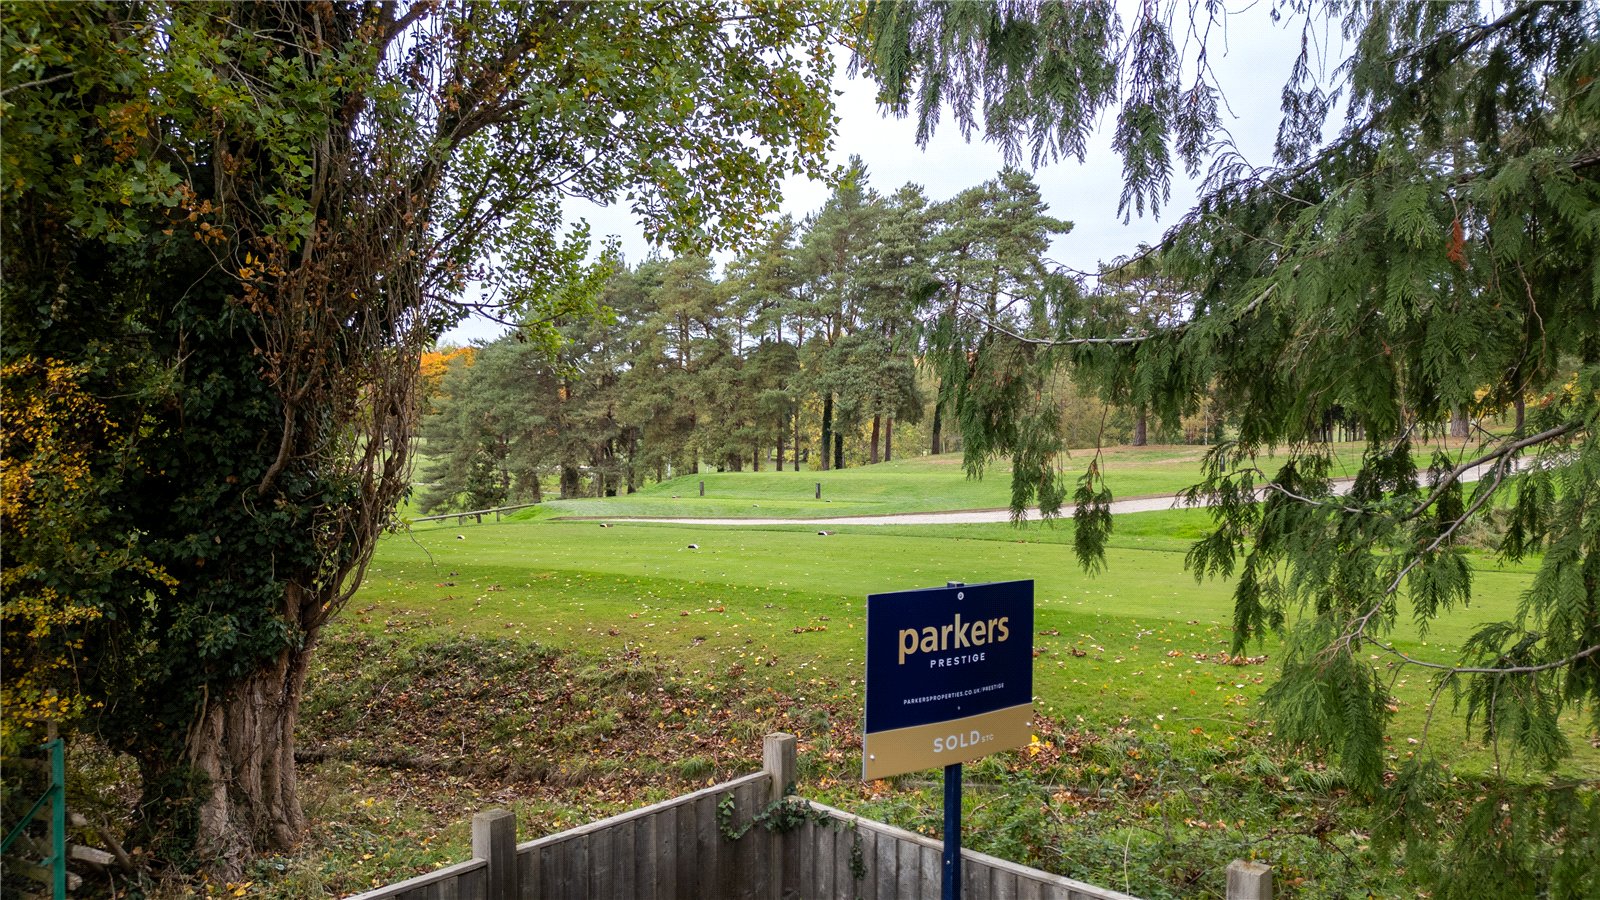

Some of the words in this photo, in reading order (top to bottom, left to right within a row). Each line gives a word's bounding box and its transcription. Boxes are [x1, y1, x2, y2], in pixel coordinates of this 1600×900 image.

[898, 613, 1010, 665] parkers
[930, 652, 986, 669] PRESTIGE
[903, 682, 1005, 705] PARKERSPROPERTIES.CO.UK/PRESTIGE
[933, 730, 980, 753] SOLD
[981, 733, 994, 743] STC
